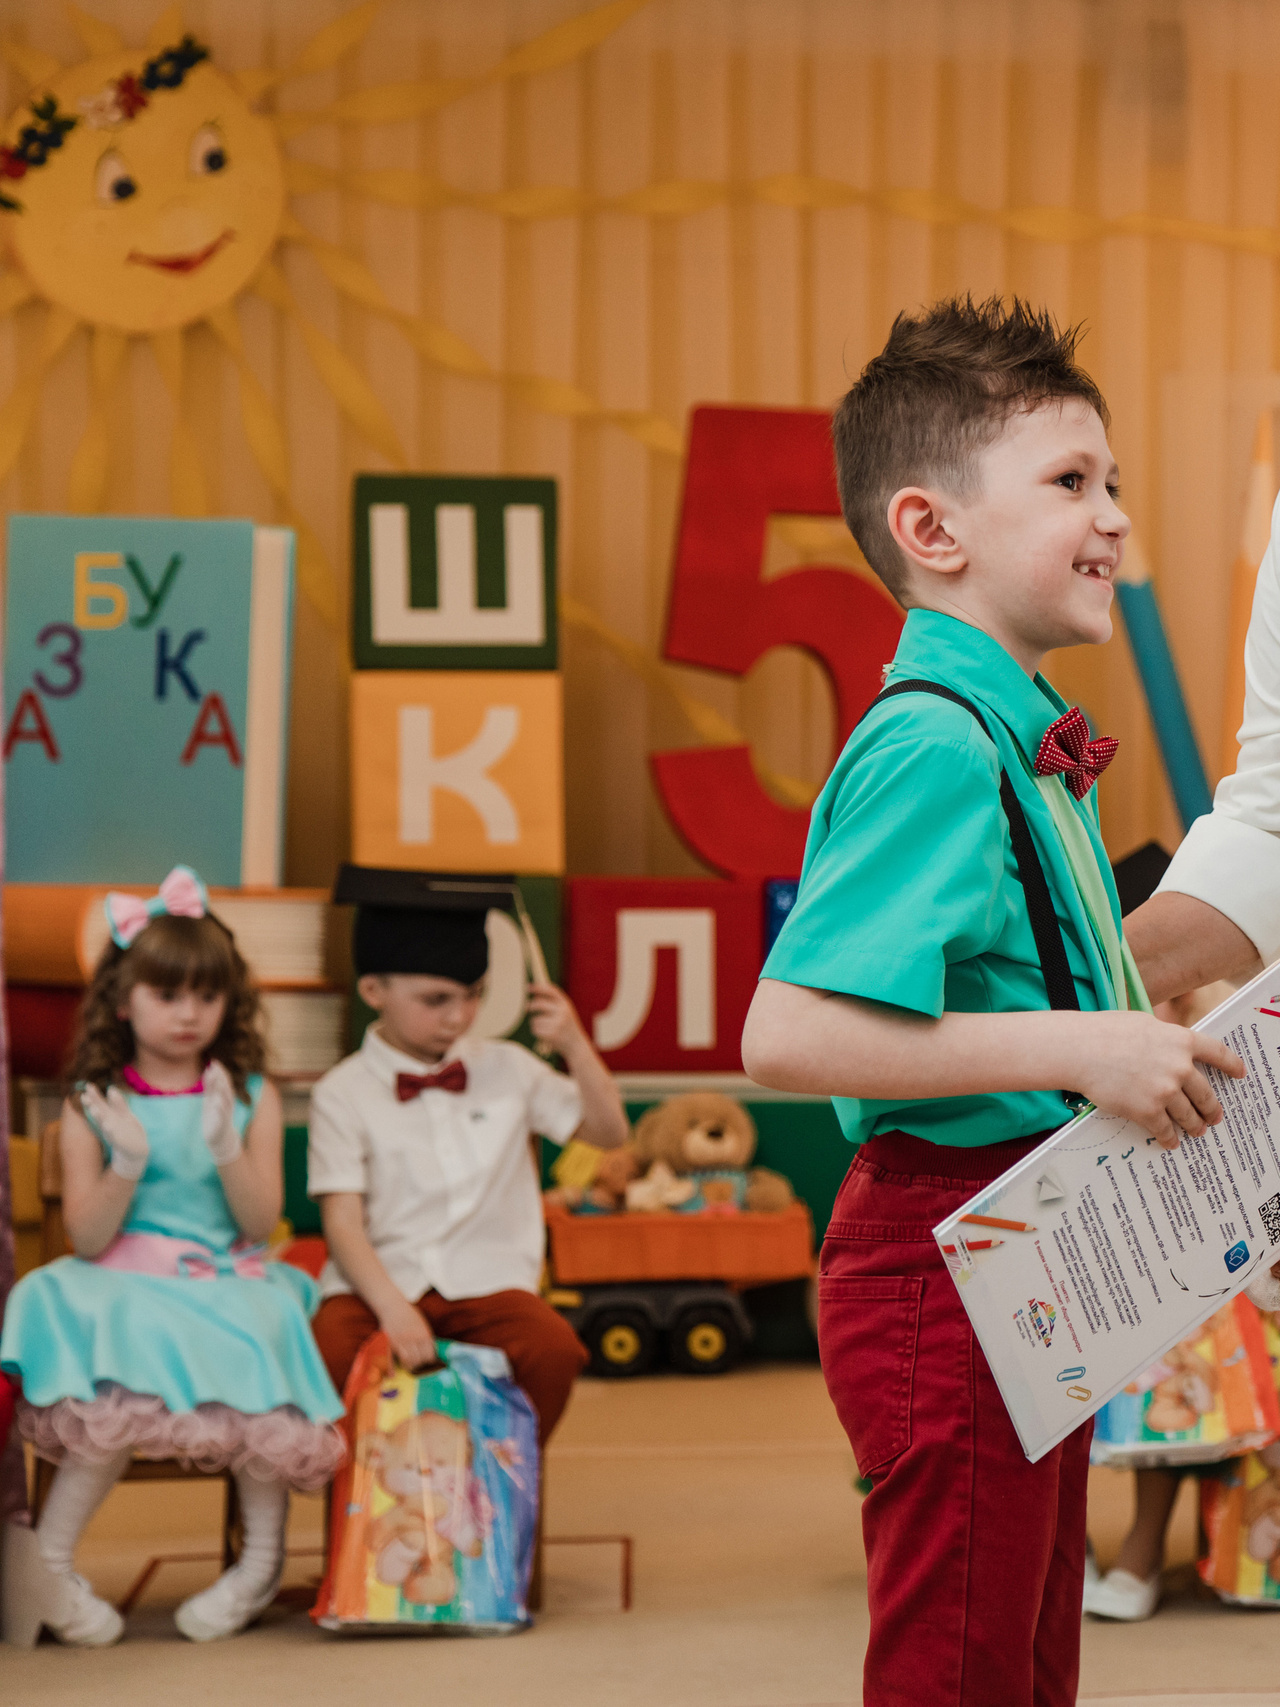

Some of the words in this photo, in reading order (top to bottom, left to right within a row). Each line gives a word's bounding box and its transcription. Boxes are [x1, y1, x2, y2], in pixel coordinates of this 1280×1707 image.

[368, 503, 547, 645] Ш
[648, 404, 908, 880] 5
[399, 705, 520, 844] К
[593, 907, 717, 1050] Л
[1230, 1029, 1241, 1055] Наведите
[1237, 1024, 1248, 1049] Откройте
[1248, 1055, 1256, 1071] своем
[1254, 1071, 1265, 1096] телефоне
[1262, 1096, 1271, 1116] камеру,
[1250, 1023, 1262, 1049] Сначала
[1259, 1049, 1275, 1086] попробуйте
[1212, 1082, 1220, 1097] фото
[1232, 1138, 1247, 1171] волшебством
[1230, 1107, 1244, 1140] дожидаемся
[1234, 1093, 1248, 1126] инструкциям
[1248, 1132, 1257, 1150] экране
[1239, 1083, 1248, 1099] далее
[1096, 1155, 1108, 1165] 4
[1121, 1146, 1134, 1159] 3
[1187, 1163, 1202, 1193] МЕМОРИС
[1192, 1134, 1206, 1162] ЕМОРИС,
[1202, 1163, 1213, 1185] которое
[1213, 1193, 1224, 1214] можете
[1200, 1132, 1209, 1149] свой
[1204, 1149, 1217, 1176] смартфон
[1126, 1160, 1139, 1187] Наведите
[1136, 1187, 1147, 1208] камеру
[1144, 1207, 1157, 1234] телефона
[1157, 1240, 1169, 1261] QR-код
[1152, 1173, 1161, 1190] будет
[1169, 1220, 1186, 1253] волшебство!
[1160, 1152, 1174, 1179] Основной
[1169, 1179, 1178, 1194] экран
[1175, 1194, 1191, 1227] приложения
[1160, 1175, 1169, 1191] экран
[1166, 1191, 1183, 1229] сканирования,
[1167, 1156, 1182, 1184] установки
[1179, 1184, 1192, 1210] запустите
[1189, 1210, 1204, 1243] приложение.
[1193, 1159, 1203, 1179] Google
[1206, 1193, 1215, 1209] введя
[1215, 1176, 1228, 1203] мобильное
[1218, 1150, 1234, 1183] Действуем
[1232, 1183, 1241, 1202] через
[1237, 1201, 1254, 1241] приложение.
[1052, 1230, 1068, 1264] наполненный
[1076, 1206, 1093, 1237] попробуйте
[1089, 1237, 1103, 1267] отодвинуть
[1100, 1267, 1111, 1288] камеру
[1113, 1298, 1126, 1324] подальше
[1081, 1198, 1091, 1215] магия
[1089, 1222, 1103, 1248] случится,
[1101, 1247, 1112, 1271] поэтому
[1109, 1270, 1117, 1283] если
[1114, 1282, 1123, 1297] фото
[1123, 1304, 1135, 1329] оживает,
[1084, 1184, 1092, 1198] Если
[1089, 1198, 1104, 1229] приблизить
[1102, 1228, 1112, 1249] камеру
[1109, 1248, 1125, 1281] приложения
[1122, 1281, 1134, 1305] слишком
[1131, 1304, 1141, 1326] близко,
[1104, 1165, 1118, 1190] Держите
[1115, 1190, 1126, 1213] телефон
[1124, 1213, 1132, 1224] над
[1128, 1224, 1147, 1261] фотографией
[1144, 1267, 1159, 1297] расстоянии
[1112, 1202, 1121, 1219] менее
[1119, 1220, 1129, 1237] 15-20
[1133, 1258, 1145, 1277] важно!
[1058, 1279, 1070, 1303] Памятка:
[1060, 1210, 1069, 1225] Если
[1069, 1234, 1083, 1262] выполнили
[1085, 1272, 1101, 1306] предыдущие
[1098, 1306, 1111, 1333] действия,
[1066, 1244, 1077, 1261] перед
[1073, 1262, 1081, 1276] вами
[1078, 1276, 1089, 1295] сейчас
[1027, 1298, 1044, 1330] Albums
[1040, 1327, 1051, 1348] kids
[1043, 1263, 1054, 1283] альбоме
[1051, 1283, 1063, 1305] оживает
[1060, 1305, 1070, 1322] общая
[1066, 1322, 1082, 1353] фотография
